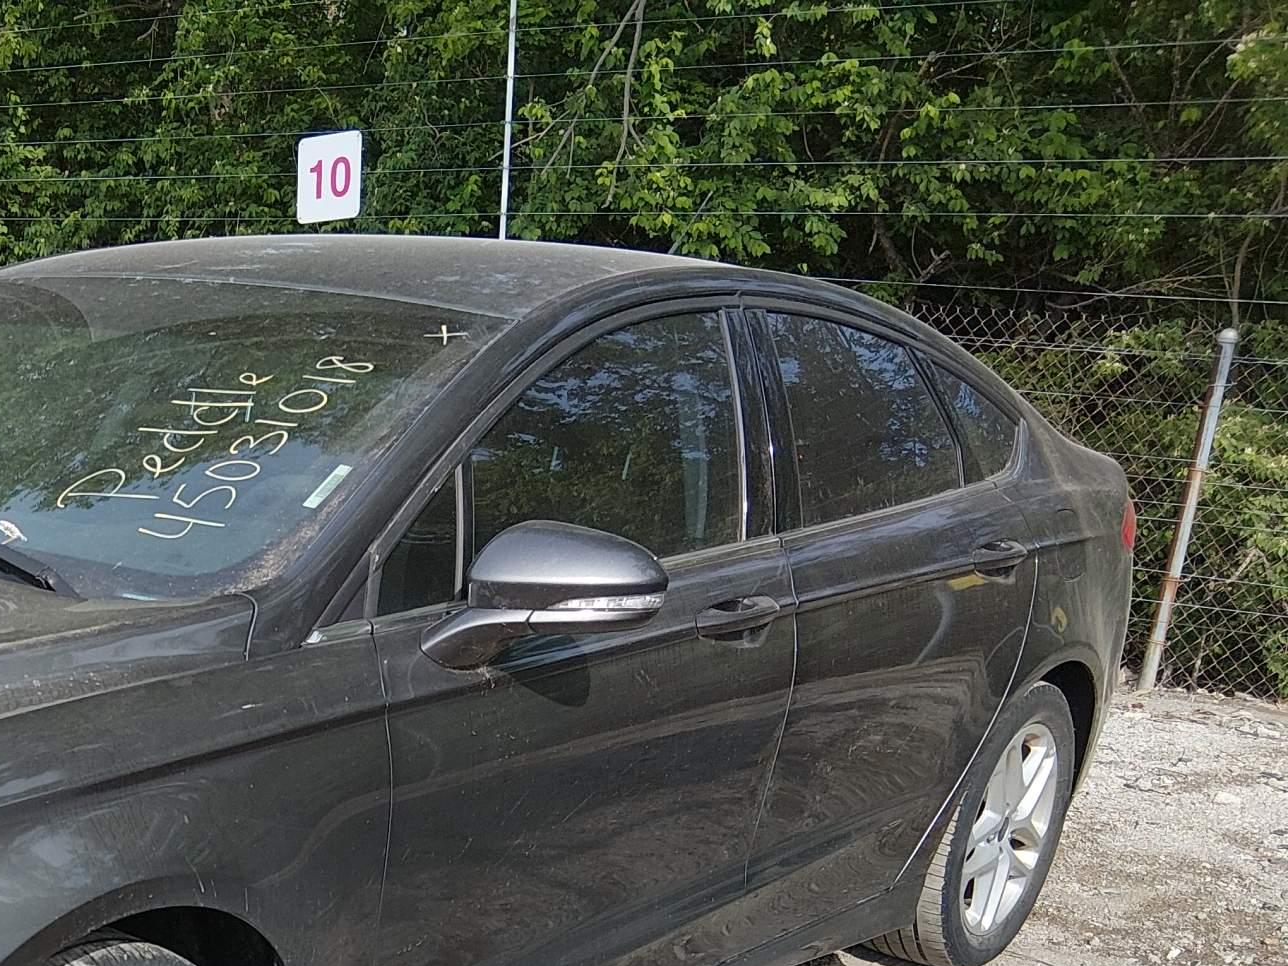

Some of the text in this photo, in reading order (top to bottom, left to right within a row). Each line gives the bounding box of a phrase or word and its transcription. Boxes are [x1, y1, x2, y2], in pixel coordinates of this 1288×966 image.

[310, 156, 351, 200] 10
[57, 371, 274, 508] Peddle
[138, 355, 374, 539] 45031018
